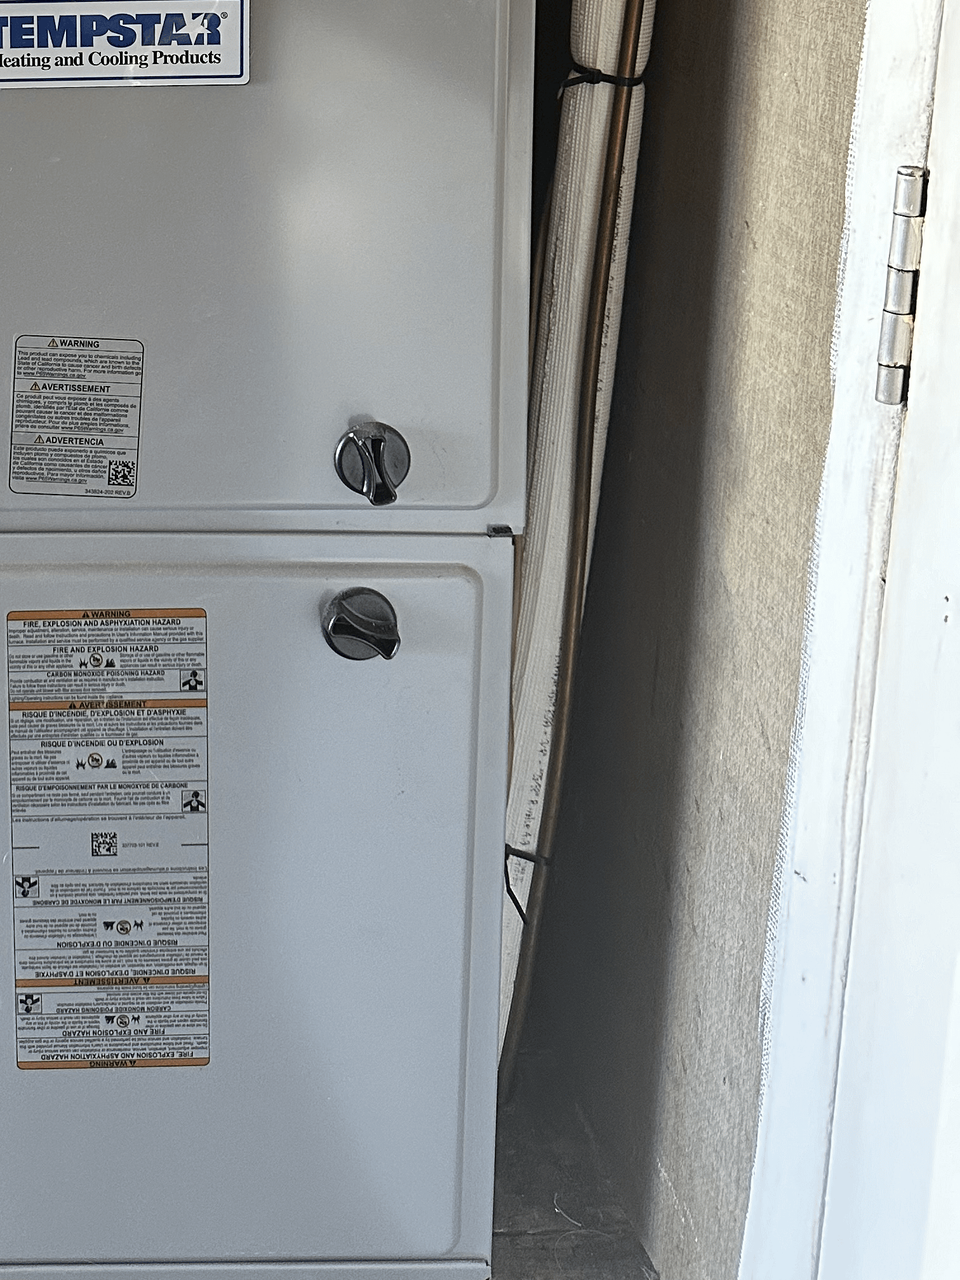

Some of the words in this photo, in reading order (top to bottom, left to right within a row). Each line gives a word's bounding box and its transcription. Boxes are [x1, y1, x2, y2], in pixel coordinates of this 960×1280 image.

[54, 51, 84, 67] and
[87, 50, 149, 69] Cooling
[151, 49, 221, 65] Products
[59, 339, 100, 348] WARNING
[41, 382, 111, 393] AVERTISSEMENT
[45, 436, 105, 446] ADVERTENCIA
[91, 610, 131, 618] WARNING
[87, 645, 128, 653] EXPLOSION
[79, 700, 147, 709] AVERTISSEMENT
[22, 710, 48, 718] RISQUE
[49, 710, 89, 718] D'INCENDIE,
[90, 709, 135, 717] D'EXPLOSION
[146, 708, 187, 716] D'ASPHYXIE
[40, 740, 66, 748] RISQUE
[67, 740, 106, 748] D'INCENDIE
[119, 739, 164, 747] D'EXPLOSION
